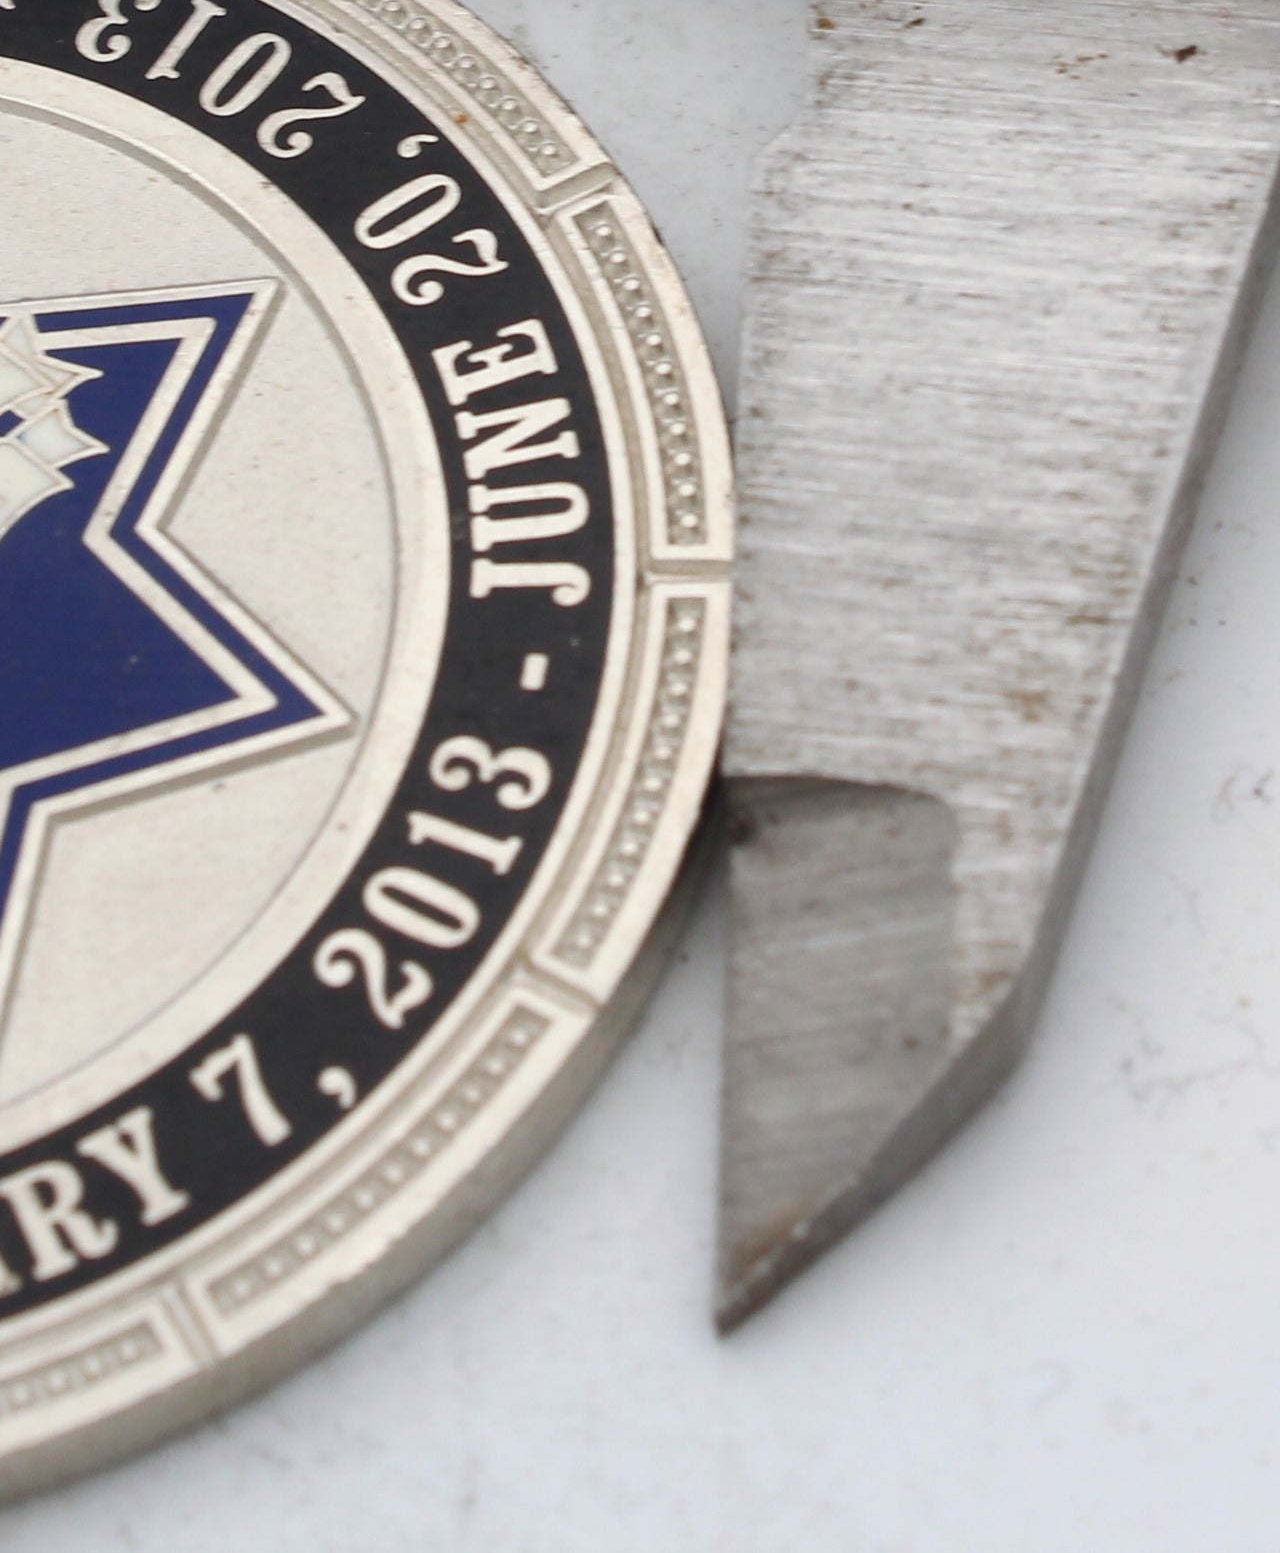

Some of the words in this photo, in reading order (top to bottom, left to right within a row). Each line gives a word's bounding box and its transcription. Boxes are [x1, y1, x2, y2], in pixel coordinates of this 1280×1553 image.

[352, 132, 510, 308] 20,
[430, 317, 593, 609] JUNE
[313, 734, 553, 1030] 2013
[189, 1034, 357, 1147] 7,
